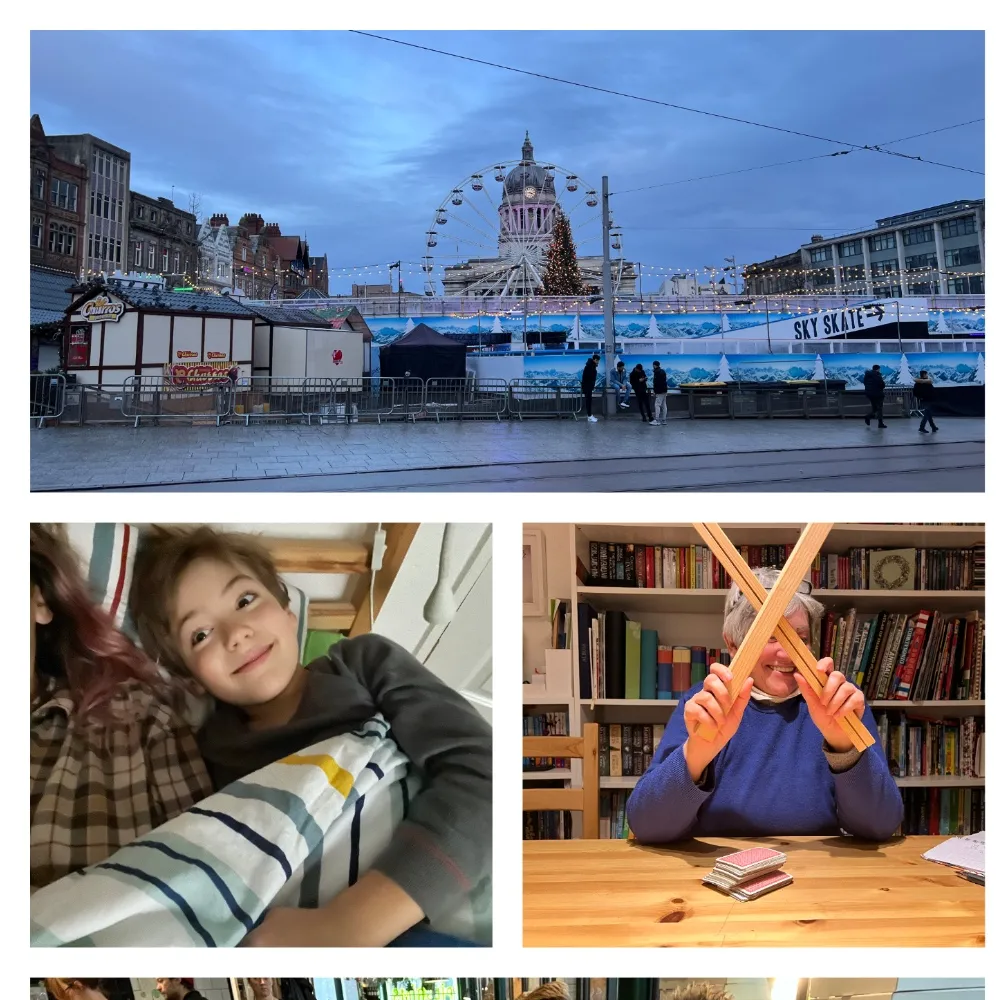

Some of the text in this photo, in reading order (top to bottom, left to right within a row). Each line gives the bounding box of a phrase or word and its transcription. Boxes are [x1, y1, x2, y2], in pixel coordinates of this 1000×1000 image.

[83, 302, 122, 316] Churros
[794, 307, 864, 339] SKY SKATE
